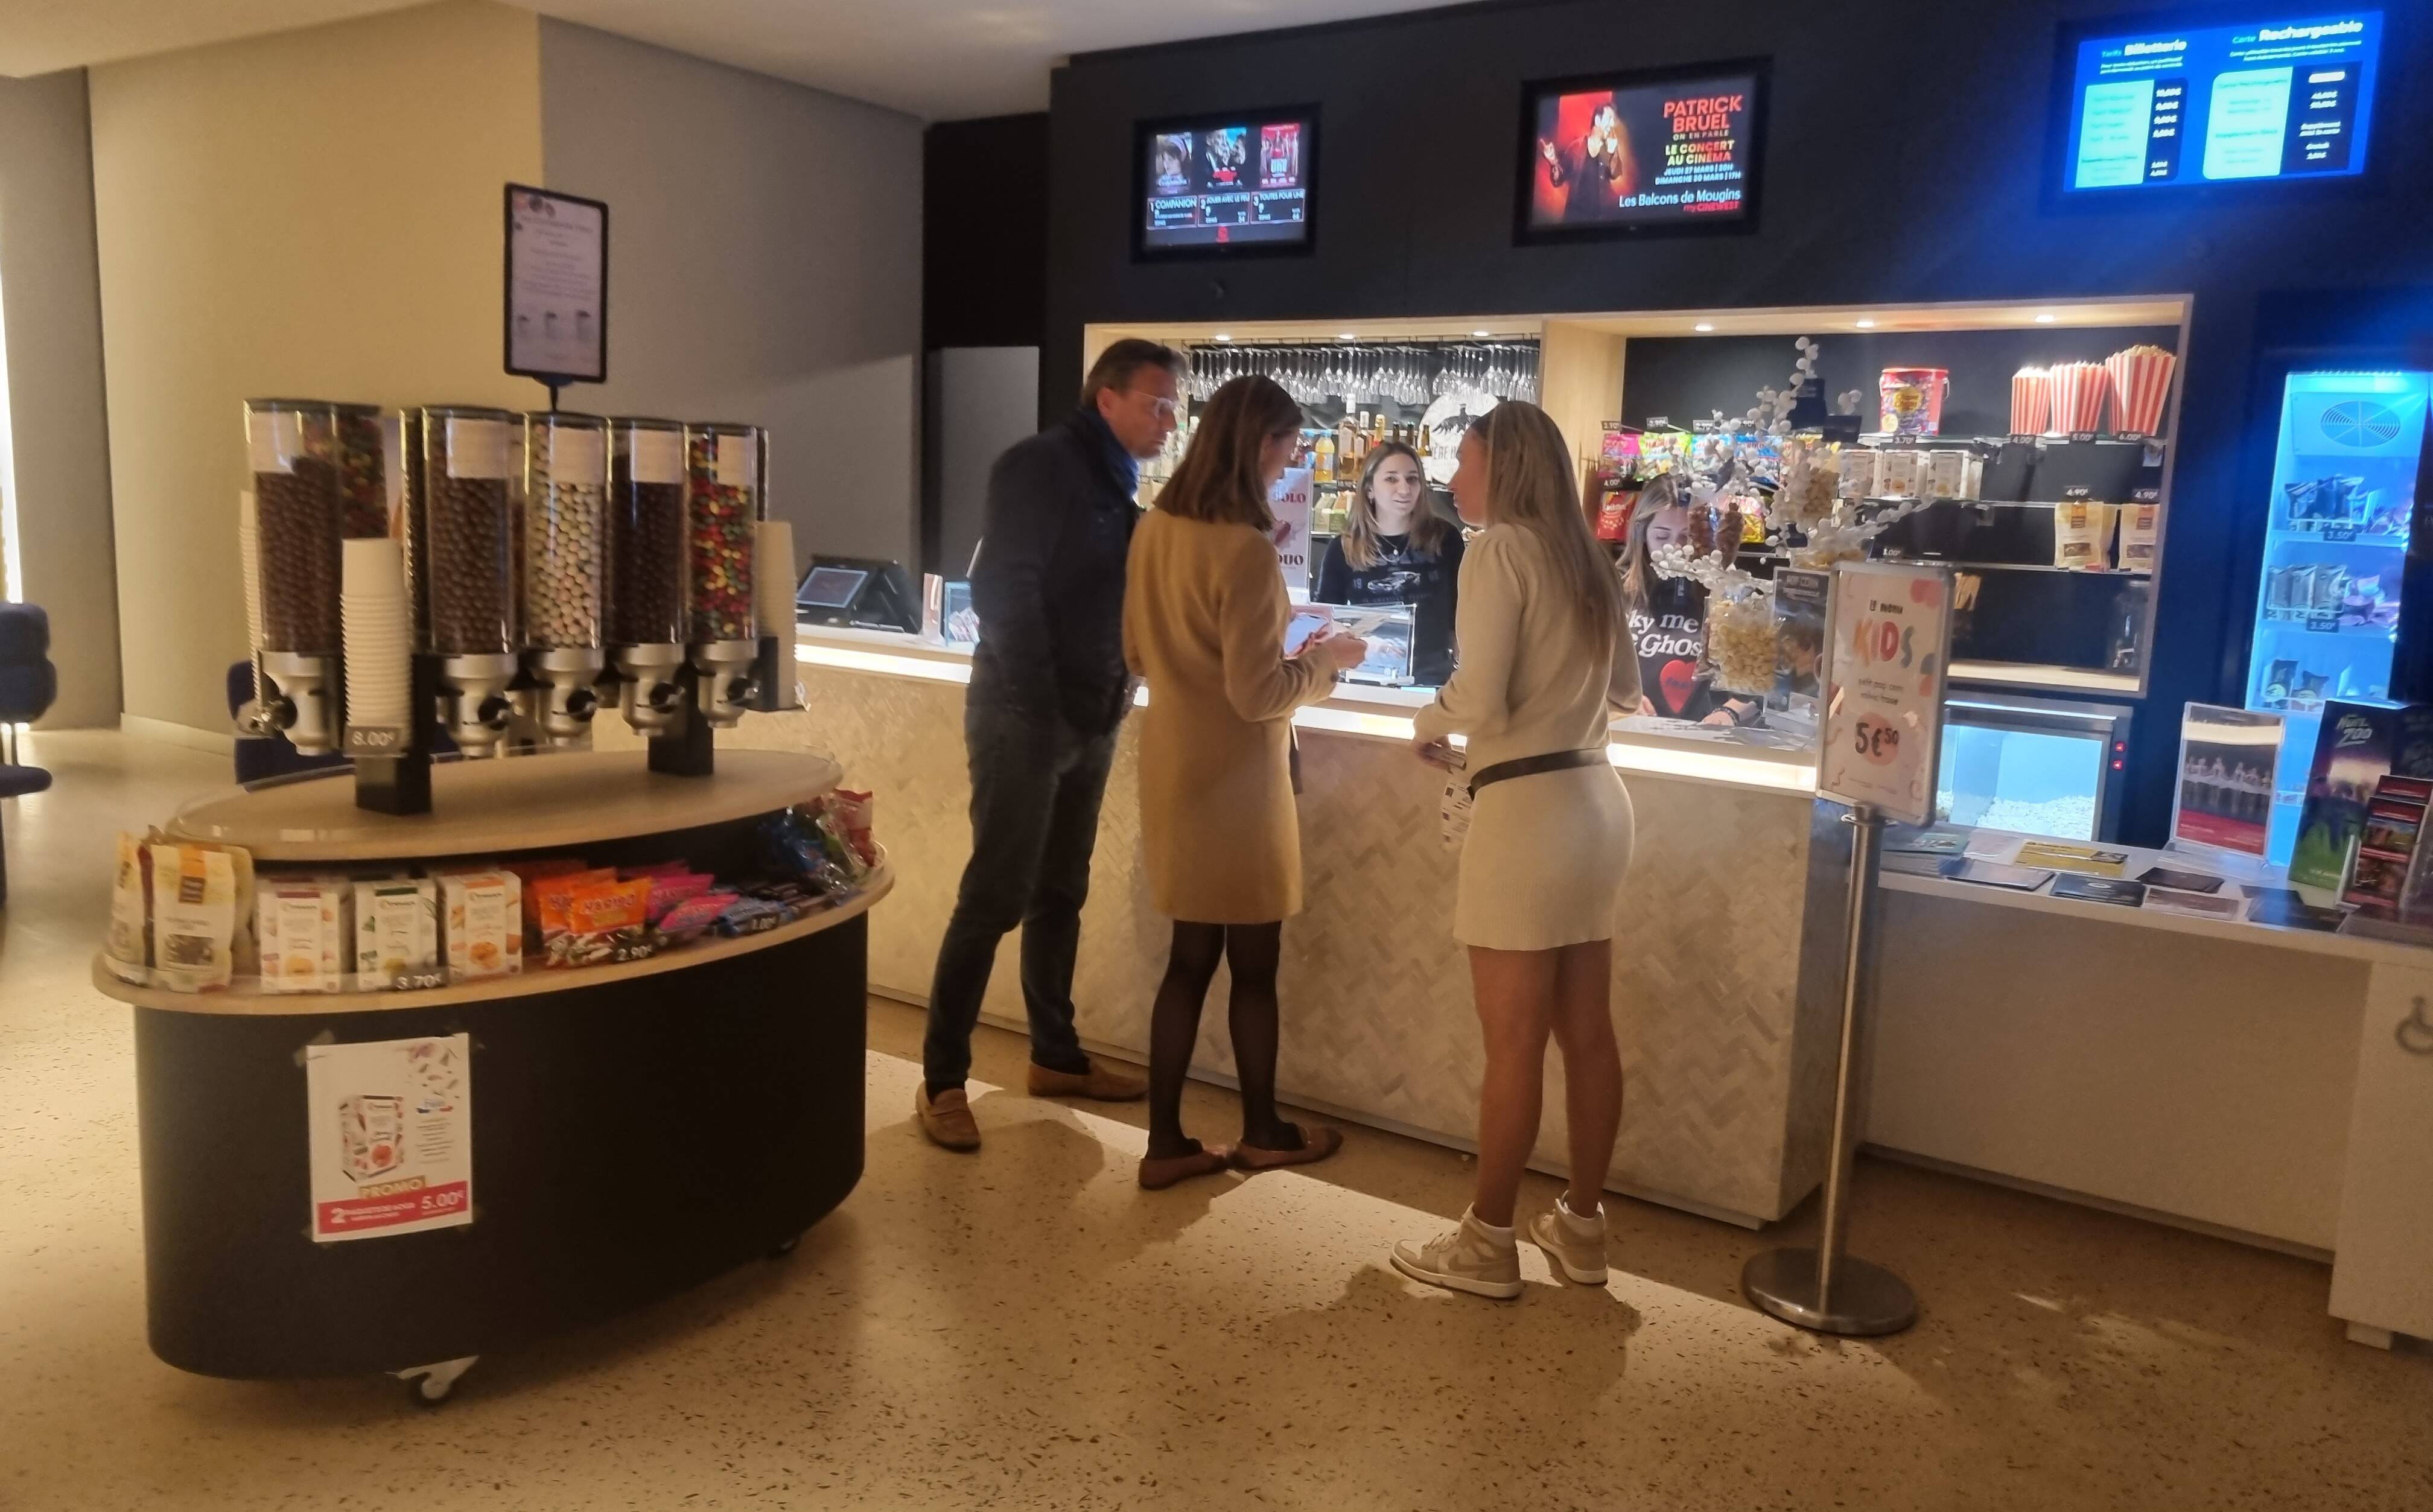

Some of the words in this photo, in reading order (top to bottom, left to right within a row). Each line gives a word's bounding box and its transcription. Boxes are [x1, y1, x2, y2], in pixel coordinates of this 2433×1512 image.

[1664, 95, 1743, 118] PATRICK
[1673, 113, 1730, 132] BRUEL
[1665, 145, 1678, 155] LE
[1679, 140, 1735, 154] CONCERT
[1667, 154, 1684, 166] AU
[1655, 176, 1692, 185] DIMANCHE
[1703, 173, 1723, 182] MARS
[1664, 167, 1684, 176] JEUDI
[1693, 165, 1714, 173] MARS
[1155, 198, 1197, 209] COMPANION
[1619, 195, 1636, 208] Les
[1638, 192, 1678, 207] Balcons
[1680, 190, 1694, 204] de
[1696, 188, 1741, 203] Mougins
[1659, 614, 1699, 633] me
[1638, 634, 1703, 658] Ghos
[1853, 618, 1915, 669] KIDS
[331, 1207, 346, 1224] 2
